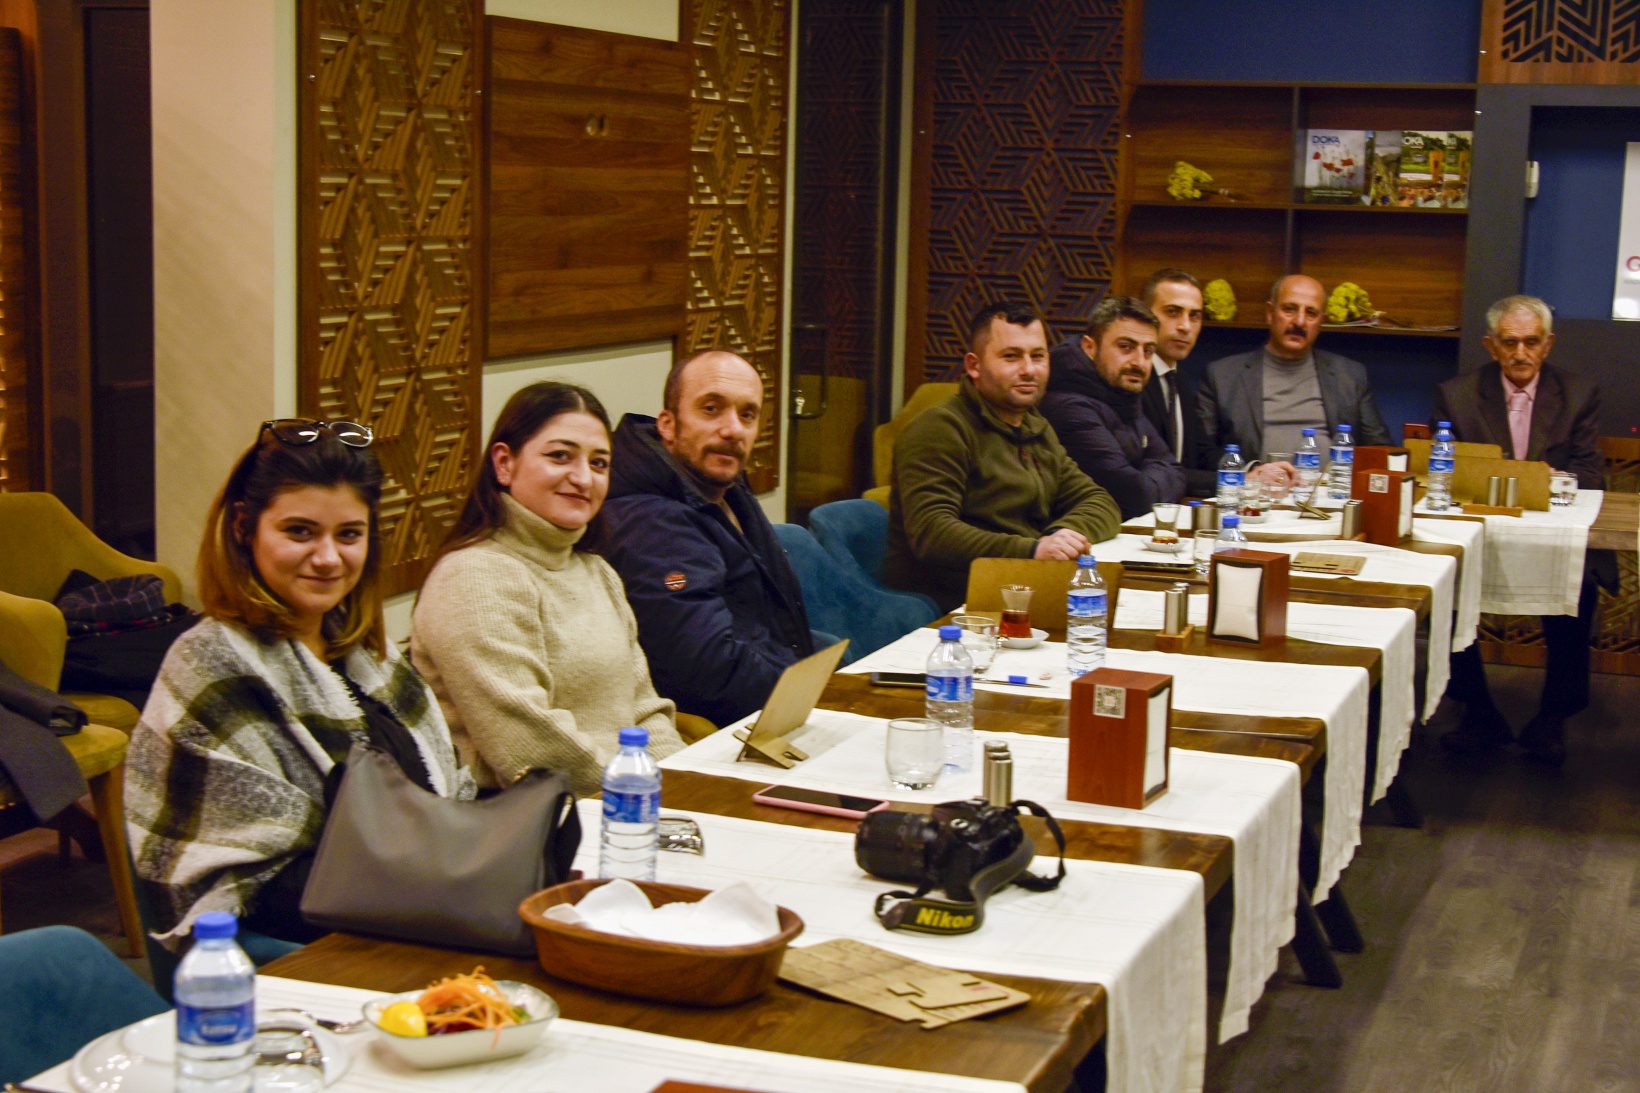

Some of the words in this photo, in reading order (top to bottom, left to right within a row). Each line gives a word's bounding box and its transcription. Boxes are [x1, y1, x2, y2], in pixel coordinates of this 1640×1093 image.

[1312, 135, 1341, 144] DOKA
[1401, 136, 1425, 145] OKA
[915, 907, 975, 929] Nikon
